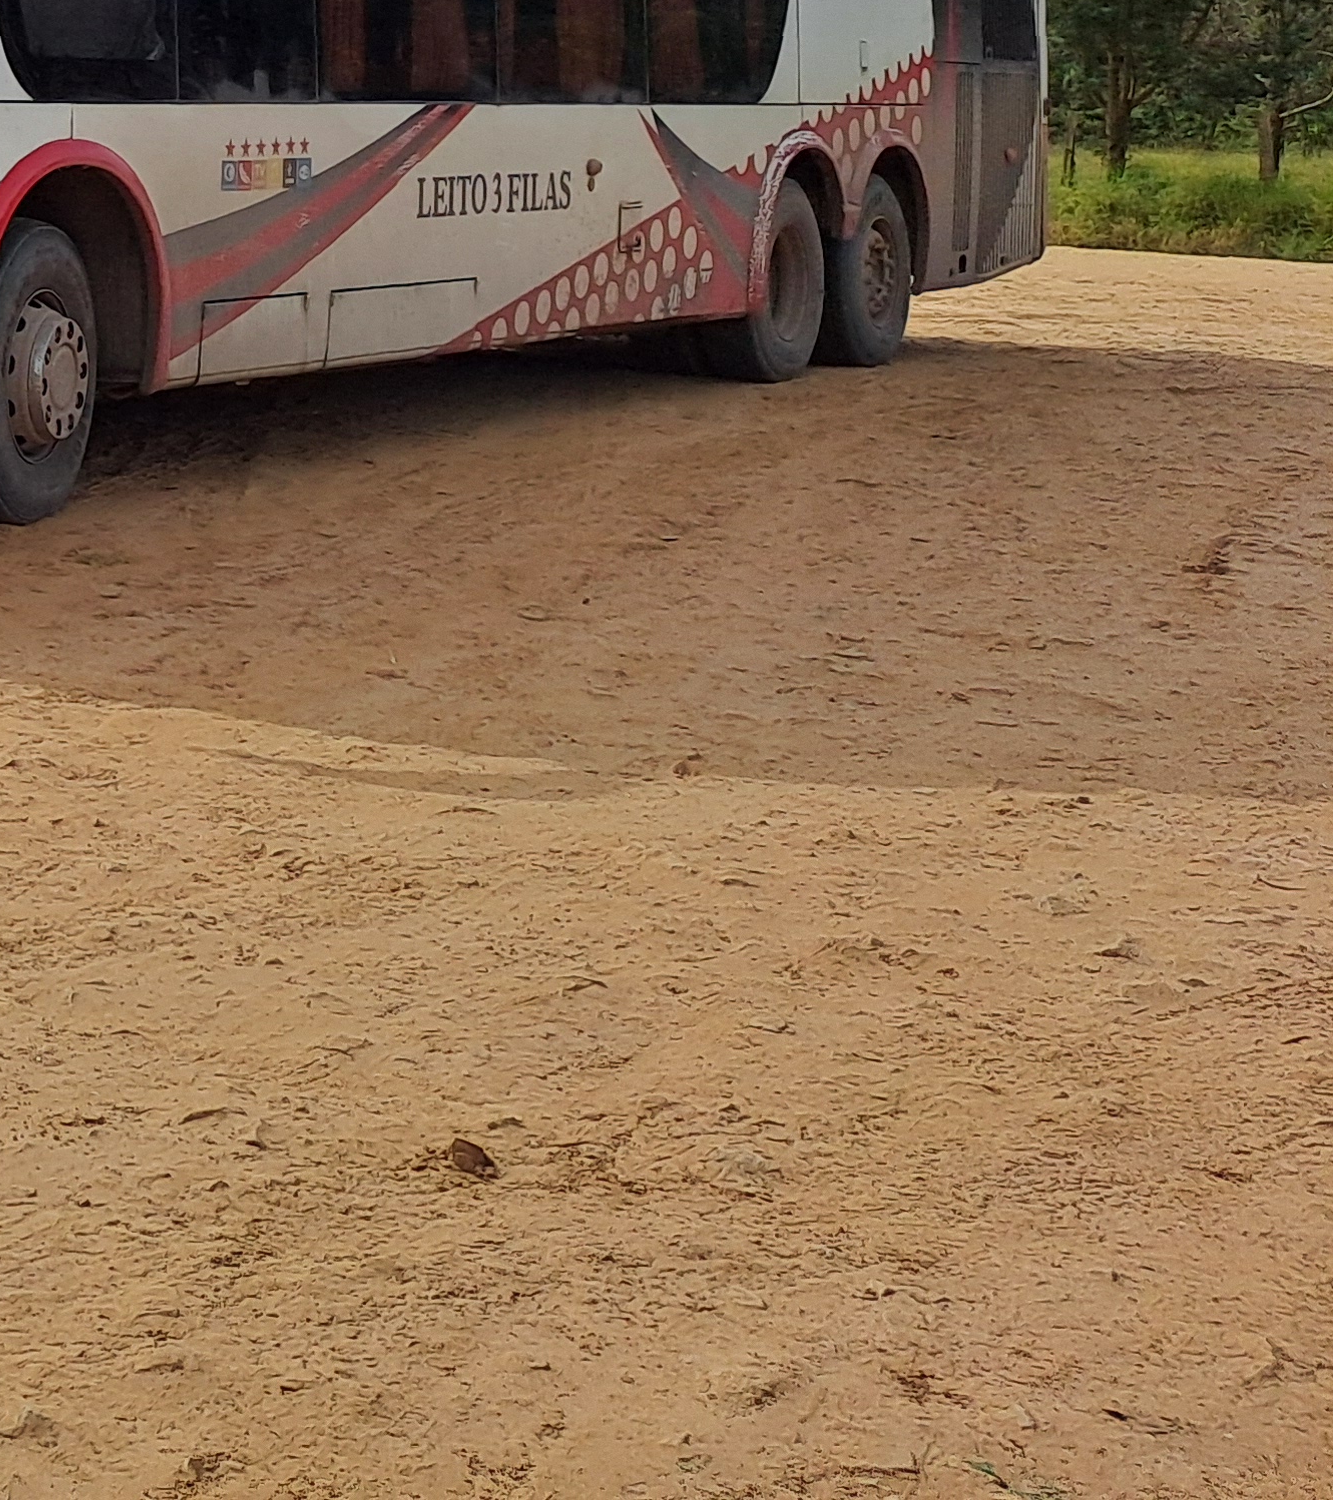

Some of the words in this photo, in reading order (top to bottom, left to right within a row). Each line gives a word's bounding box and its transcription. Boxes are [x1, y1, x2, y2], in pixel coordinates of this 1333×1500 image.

[416, 173, 487, 218] LEITO
[491, 172, 503, 214] 3
[506, 169, 572, 213] FILAS
